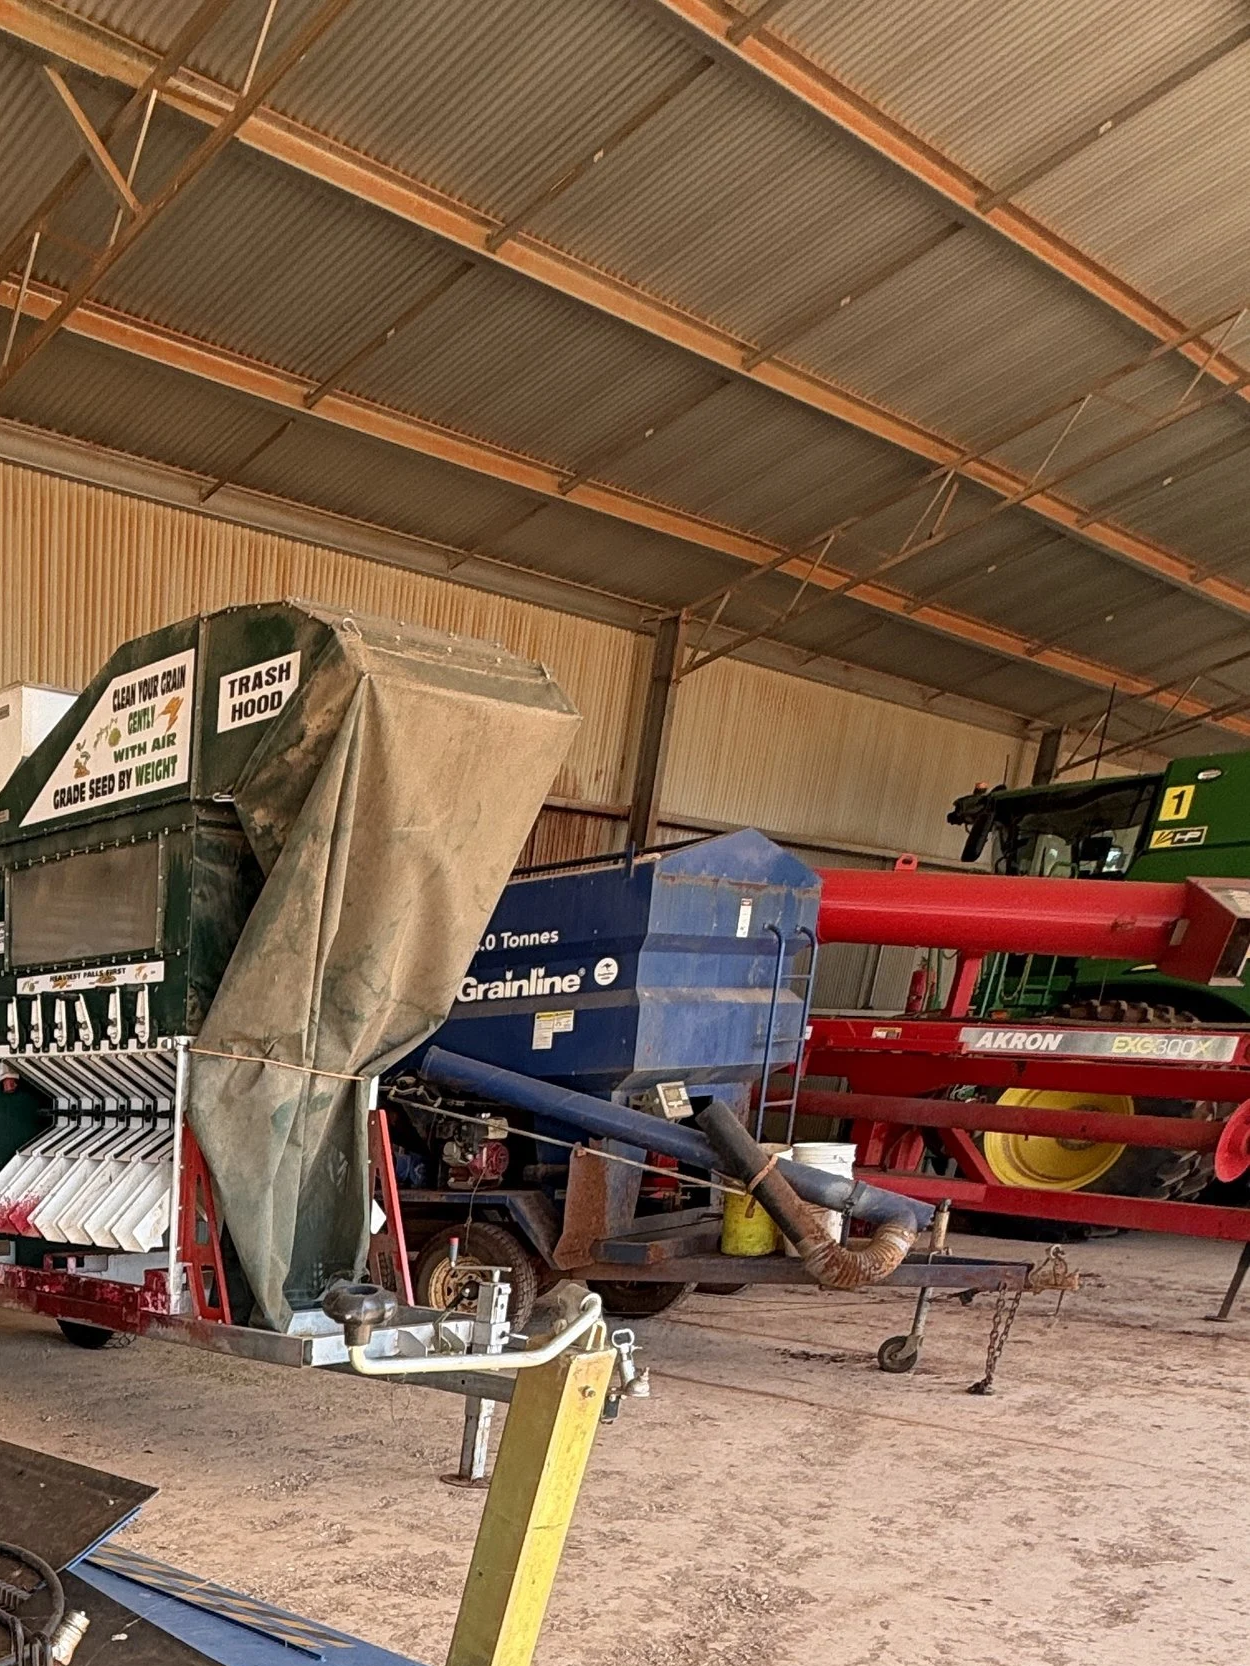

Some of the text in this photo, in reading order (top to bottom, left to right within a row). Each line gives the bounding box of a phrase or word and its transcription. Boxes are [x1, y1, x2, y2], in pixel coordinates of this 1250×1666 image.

[112, 664, 187, 713] CLEAN YOUR GRAIN
[228, 661, 292, 698] TRASH
[127, 704, 156, 736] GENTLY
[231, 690, 283, 723] HOOD
[113, 732, 177, 764] WITH AIR
[53, 755, 178, 810] GRADE SEED BY WEIGHT
[1173, 790, 1186, 815] 1
[1173, 831, 1201, 842] HP
[500, 929, 559, 949] Tonnes
[83, 969, 104, 978] FALLS
[106, 967, 127, 976] FIRST
[975, 1031, 1214, 1057] AKRON EXG300X
